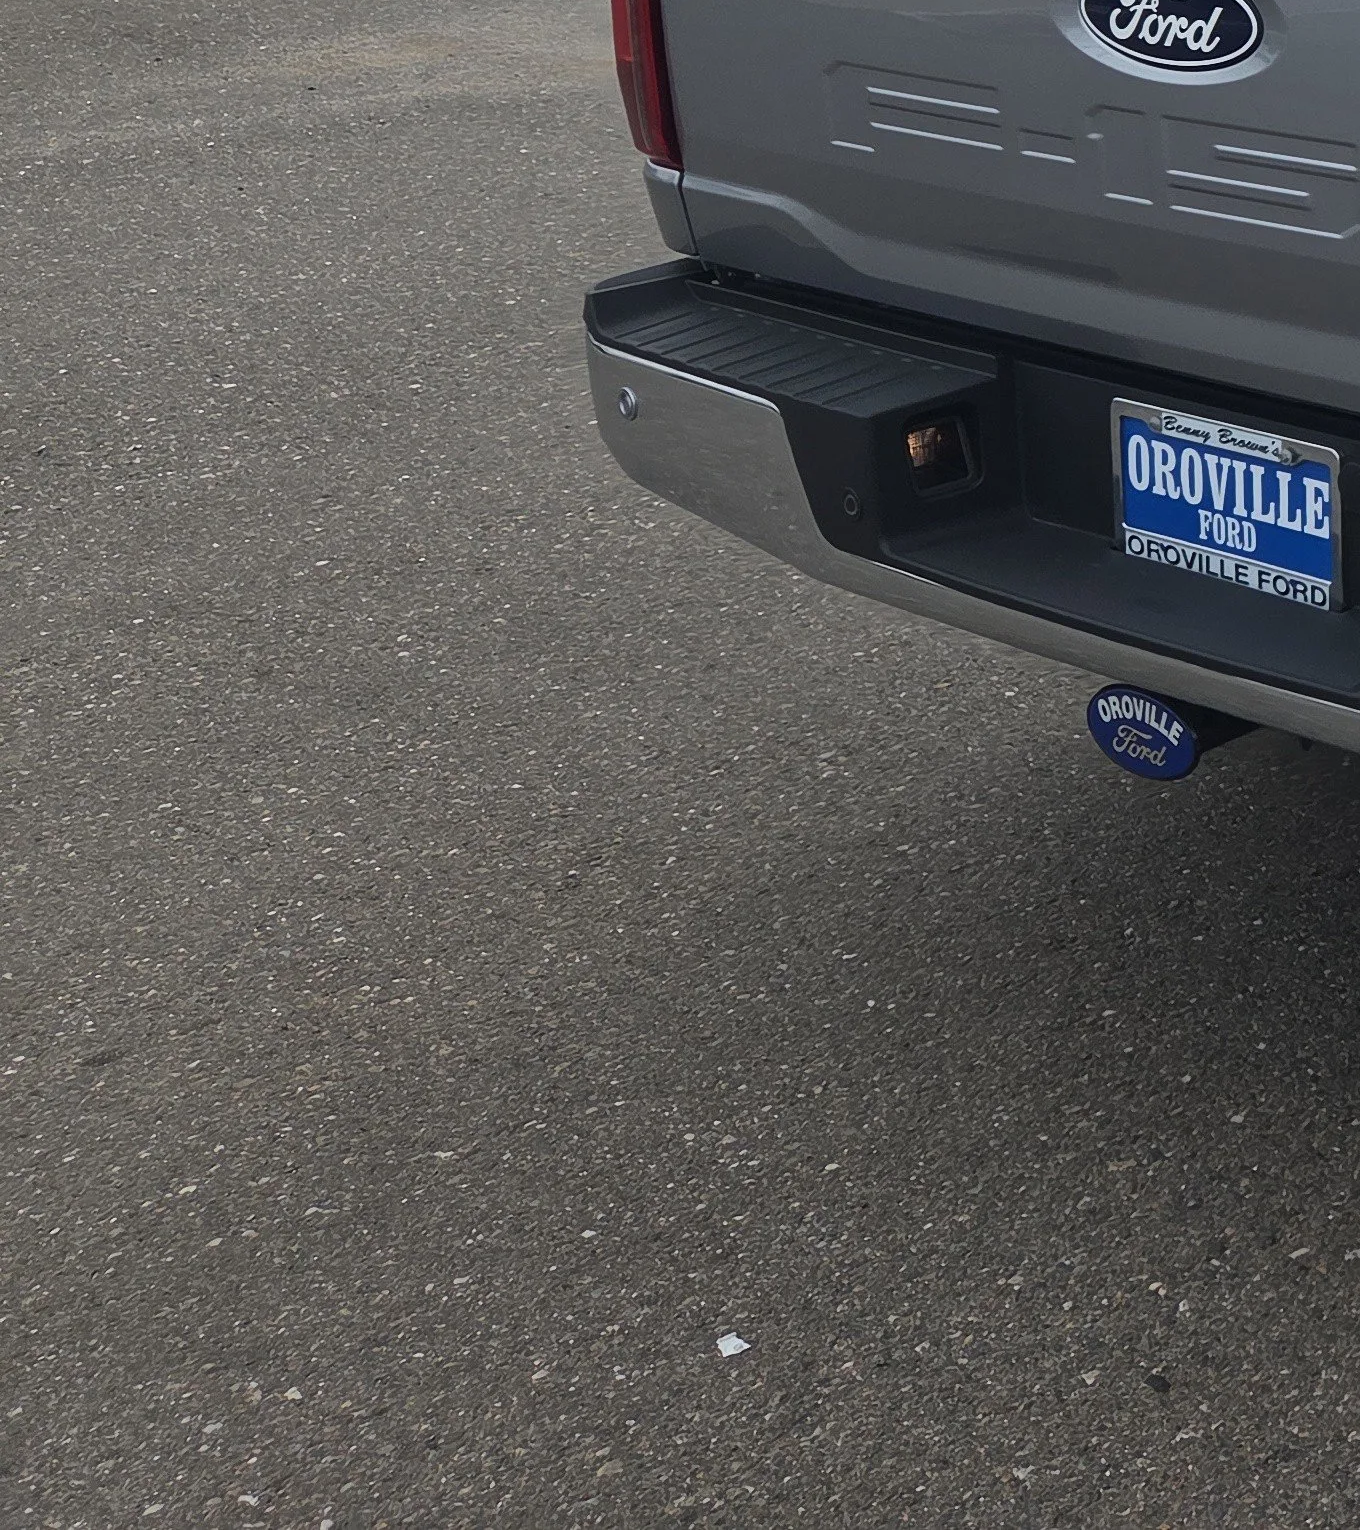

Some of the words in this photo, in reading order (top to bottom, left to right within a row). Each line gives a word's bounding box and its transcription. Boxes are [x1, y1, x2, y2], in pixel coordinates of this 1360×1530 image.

[1163, 415, 1212, 444] Benny
[1217, 428, 1285, 459] Brown's
[1127, 434, 1331, 539] OROVILLE
[1197, 508, 1257, 552] FORD
[1127, 534, 1250, 585] OROVILLE
[1257, 570, 1328, 607] FORD
[1097, 695, 1184, 747] OROVILLE
[1112, 724, 1167, 767] Ford
